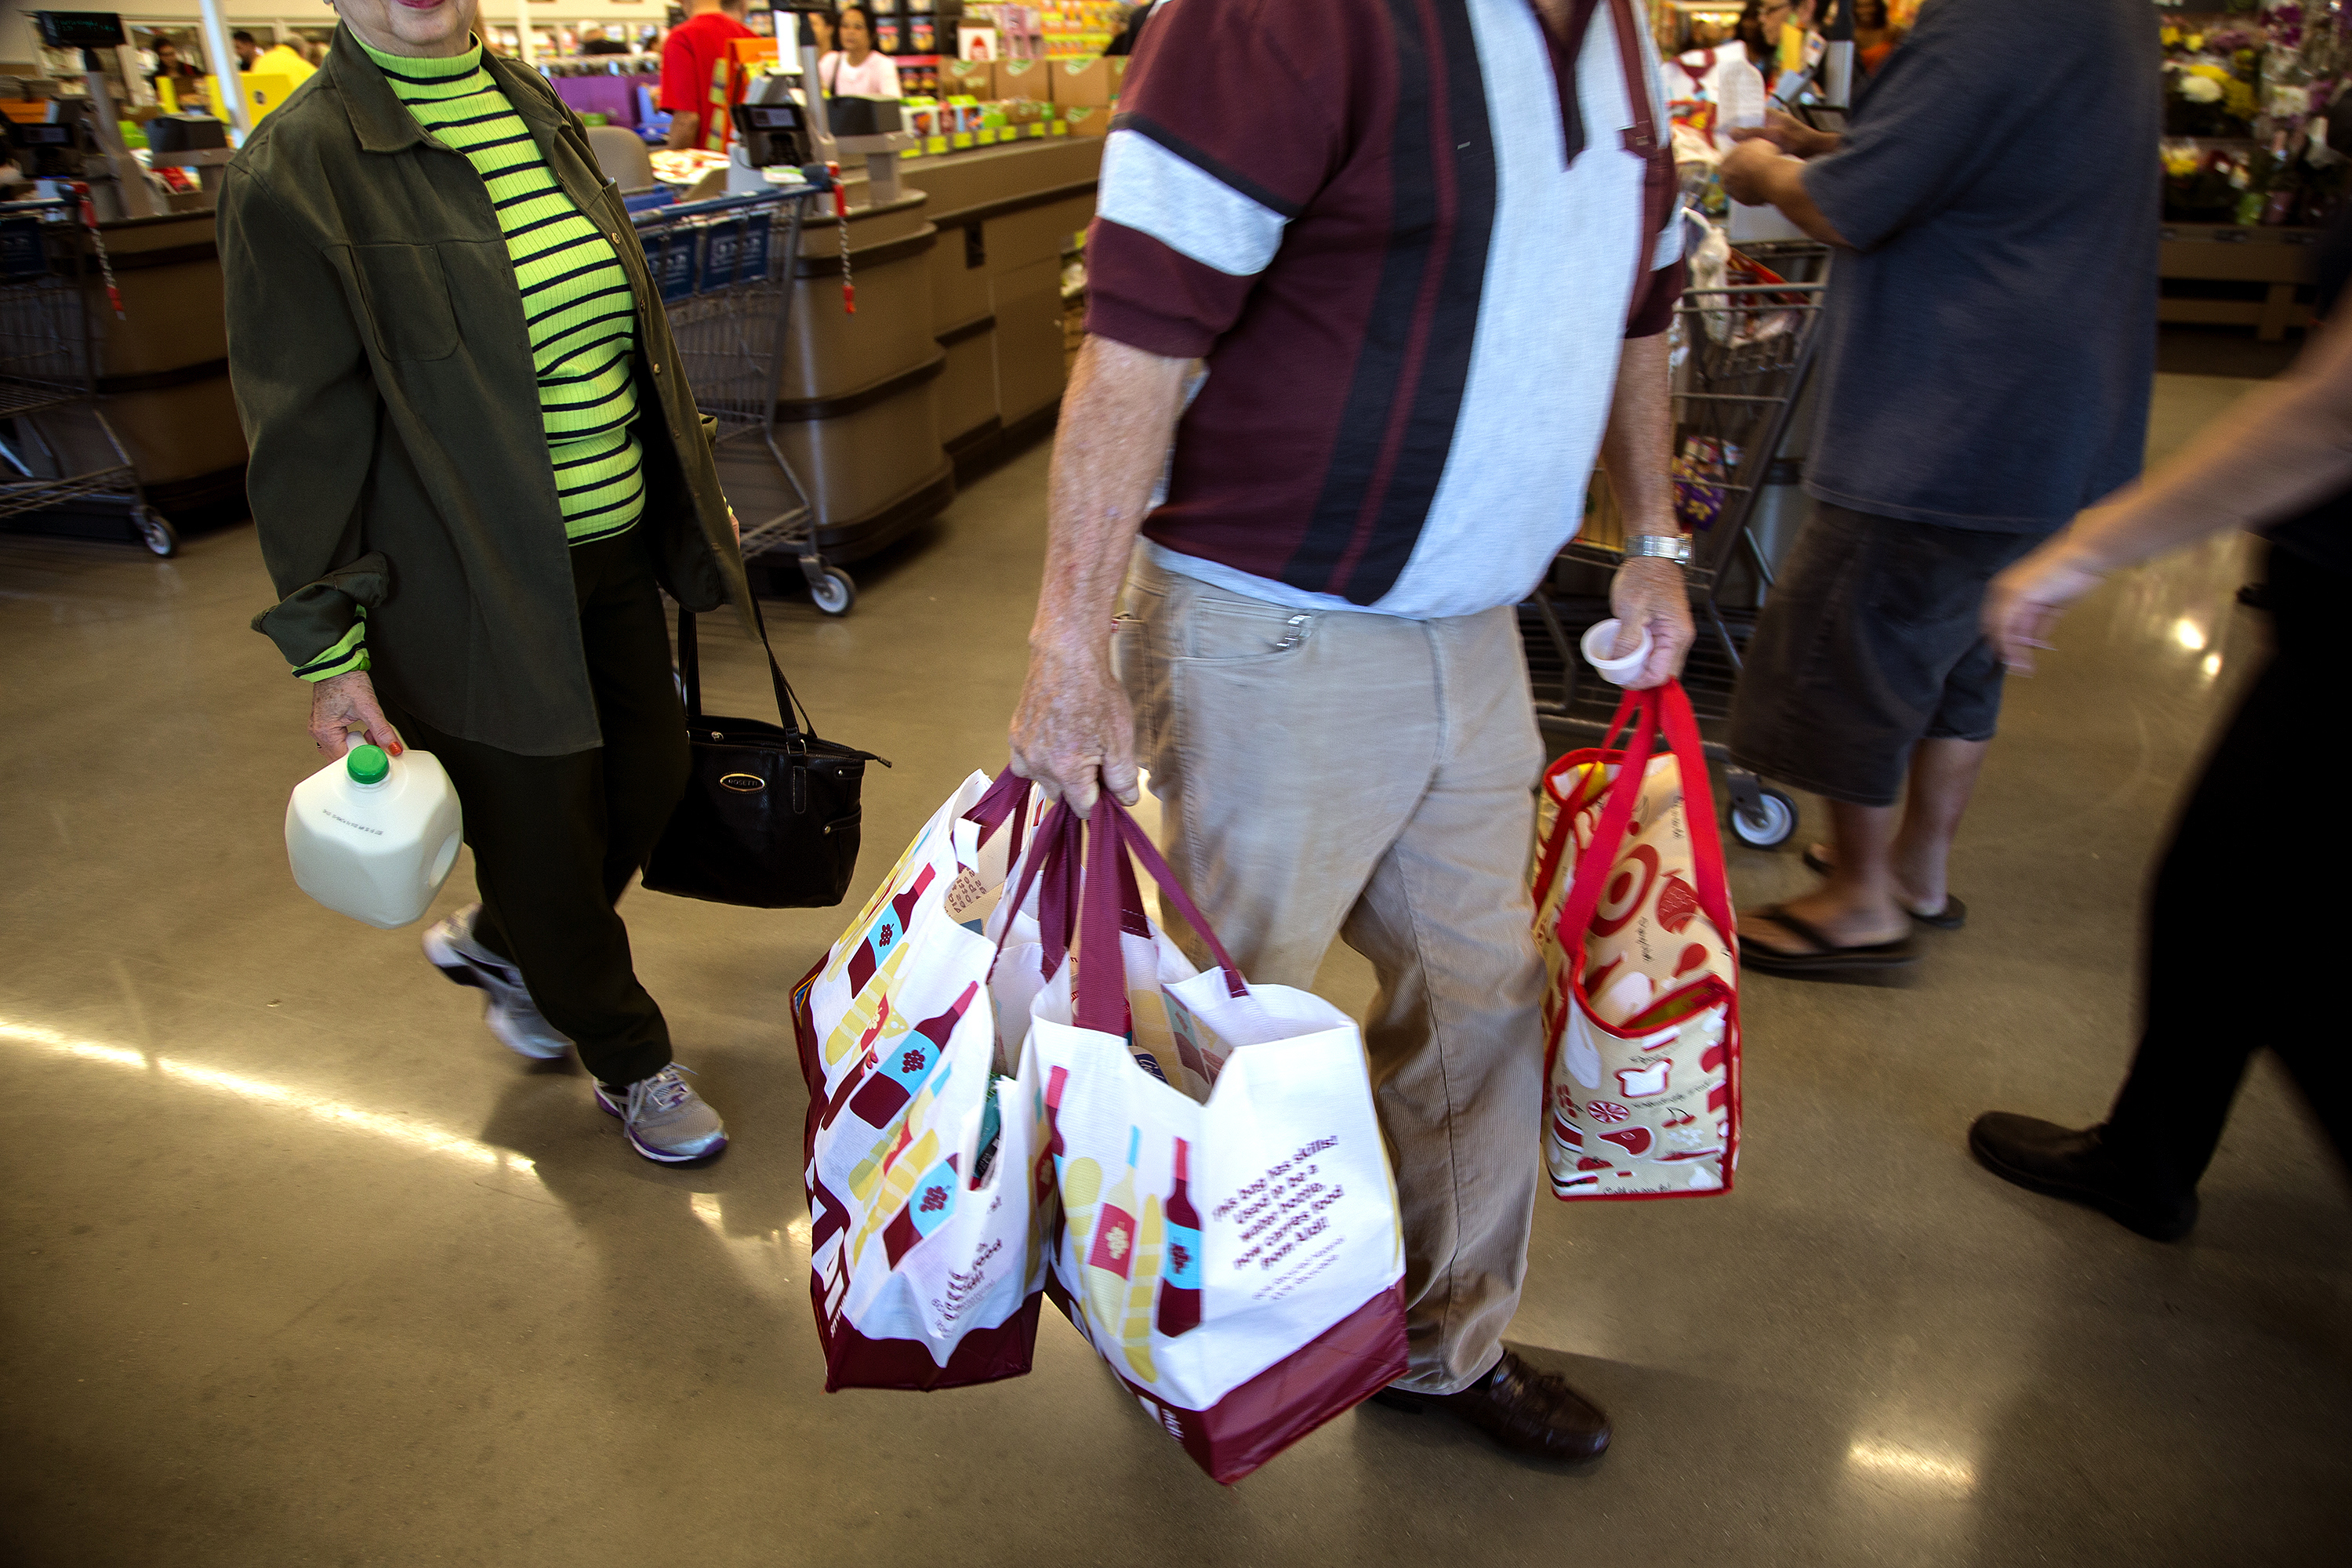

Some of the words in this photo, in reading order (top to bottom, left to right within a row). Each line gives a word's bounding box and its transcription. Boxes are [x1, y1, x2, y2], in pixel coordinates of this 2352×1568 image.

[1236, 1178, 1269, 1200] bag
[1265, 1160, 1294, 1181] has
[1292, 1135, 1338, 1163] skills!
[1286, 1172, 1308, 1189] be
[1307, 1164, 1319, 1175] a
[1239, 1211, 1279, 1243] water
